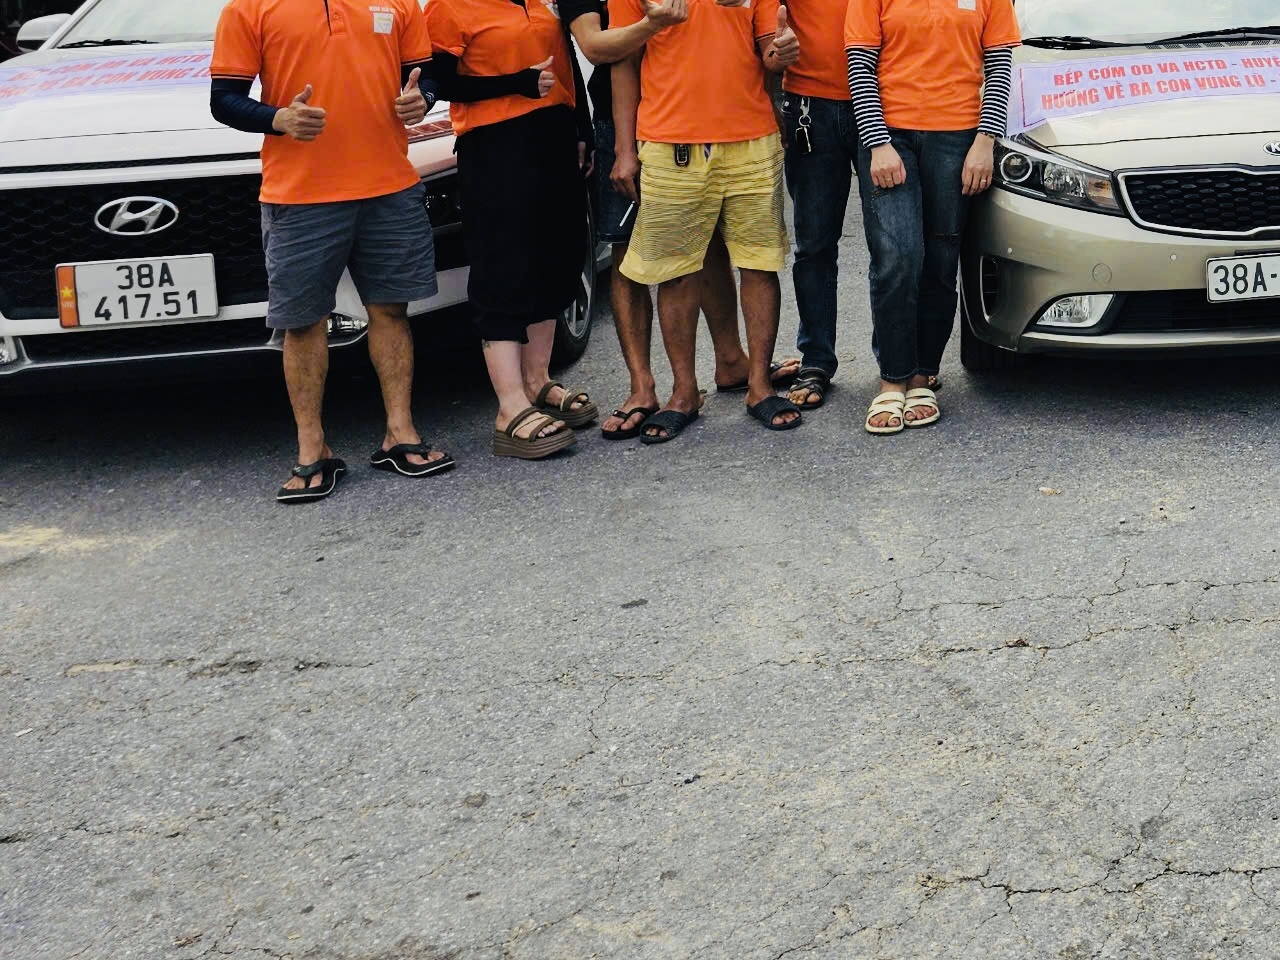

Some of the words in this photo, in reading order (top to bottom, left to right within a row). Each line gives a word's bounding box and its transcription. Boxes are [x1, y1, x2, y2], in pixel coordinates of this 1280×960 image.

[1054, 68, 1083, 86] BẾP
[1089, 66, 1126, 80] CƠM
[1157, 78, 1191, 93] CON
[116, 262, 175, 290] 38A
[94, 290, 199, 321] 417.51
